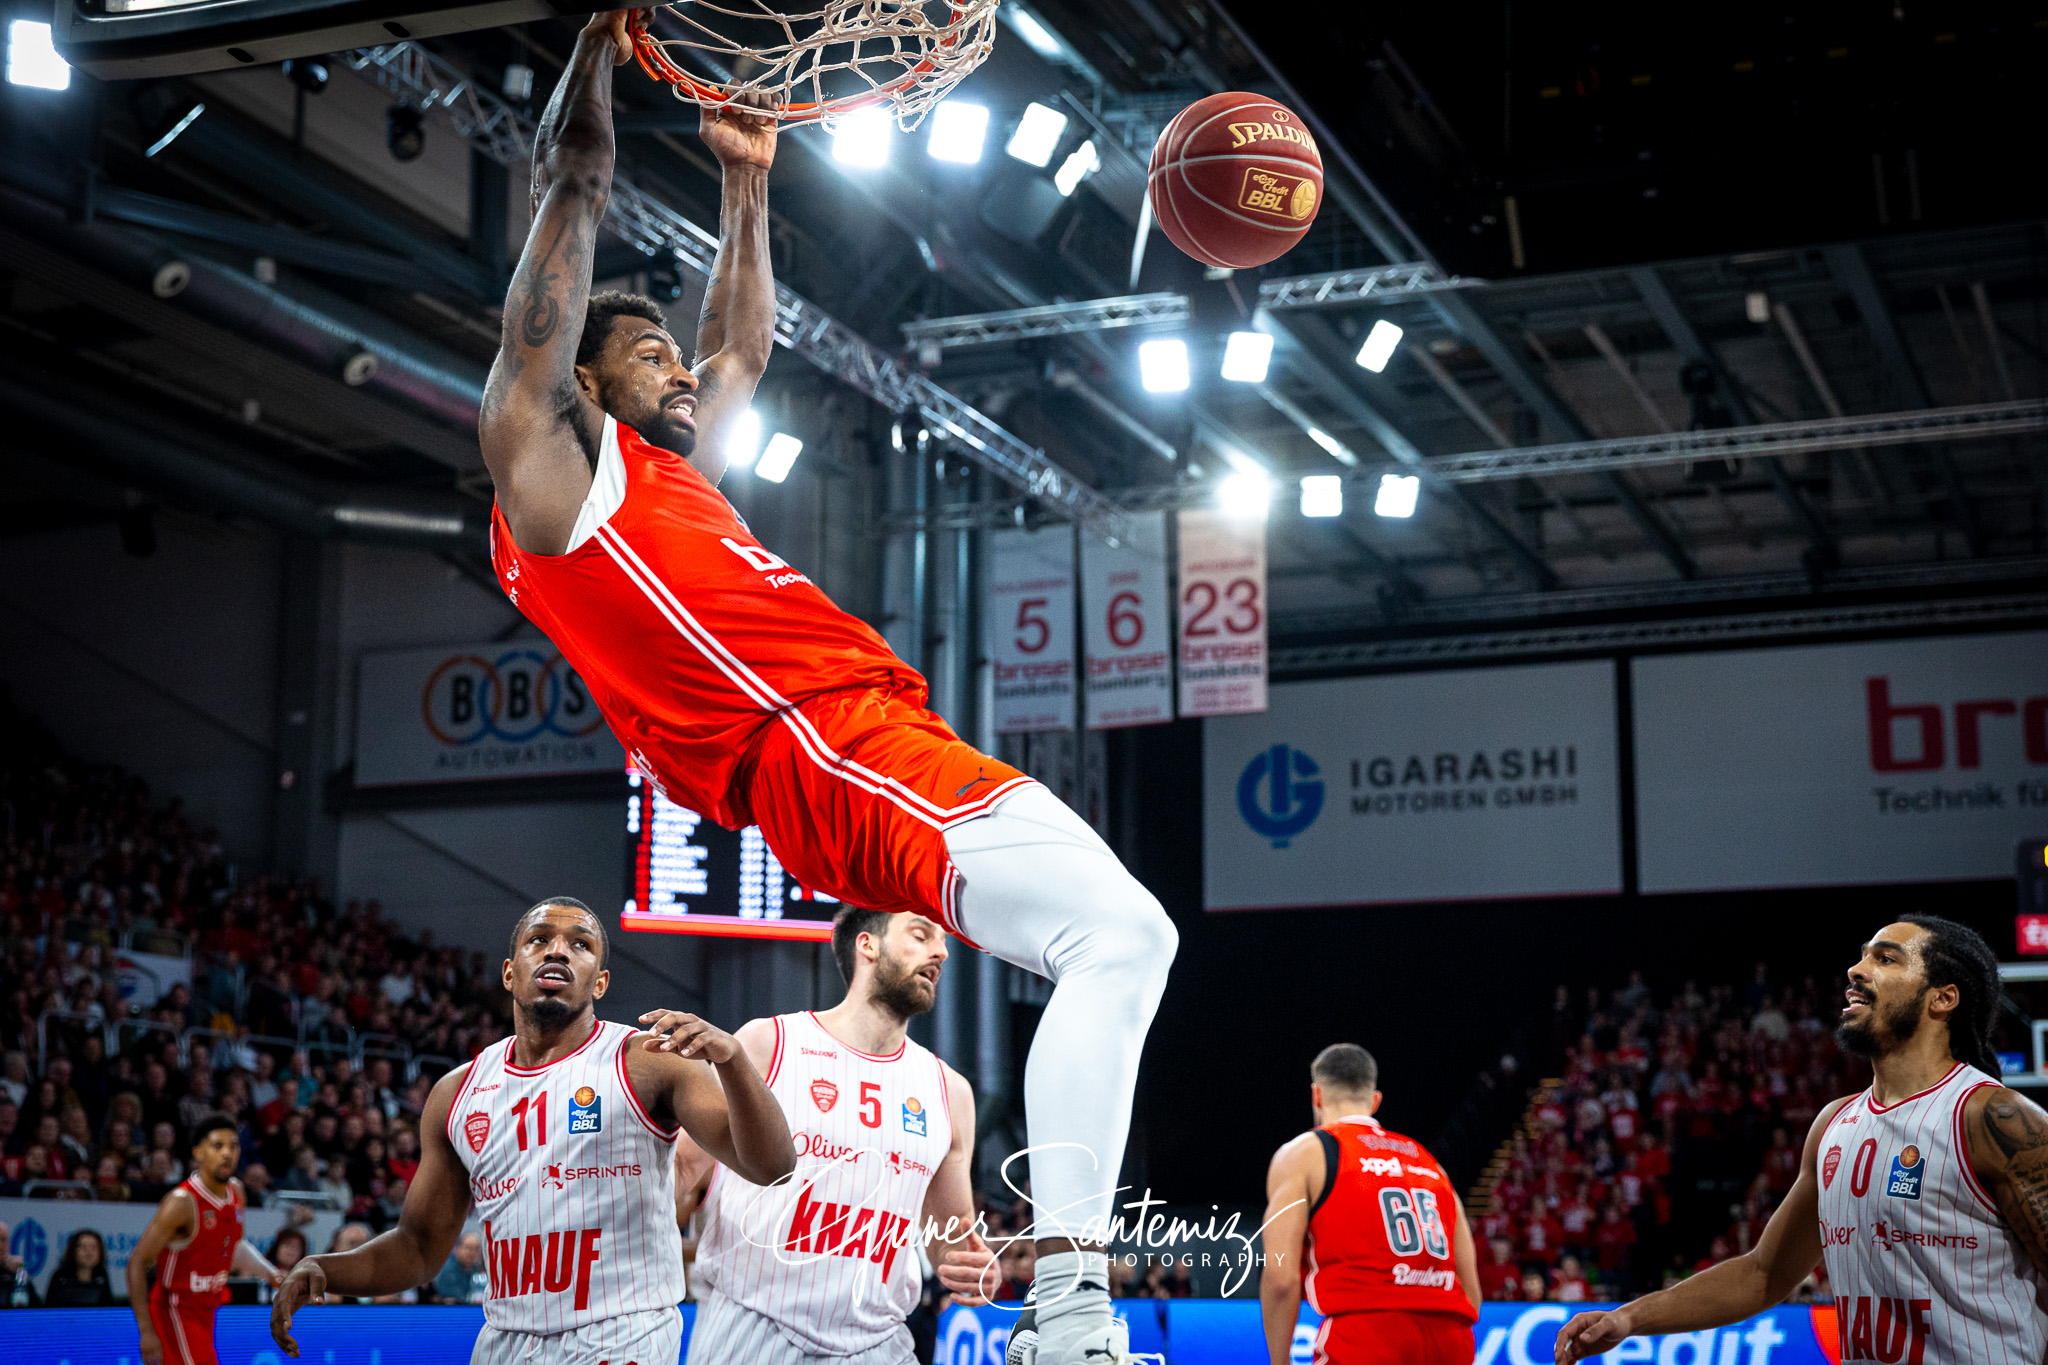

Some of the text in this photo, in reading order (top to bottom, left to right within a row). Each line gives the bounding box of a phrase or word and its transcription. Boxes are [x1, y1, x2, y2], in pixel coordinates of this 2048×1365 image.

[1228, 121, 1321, 164] SPALDIN
[1246, 190, 1284, 212] BBL
[1015, 597, 1051, 654] 5
[1106, 591, 1145, 649] 6
[1184, 578, 1261, 637] 23
[452, 666, 587, 724] BBS
[436, 743, 597, 770] AUTOMATION
[1350, 745, 1577, 789] IGARASHI
[1350, 793, 1486, 817] MOTOREN
[1875, 784, 2003, 815] Technik
[511, 1091, 548, 1152] 11
[571, 1119, 598, 1131] BBL
[859, 1081, 882, 1128] 5
[564, 1164, 642, 1180] SPRINTIS
[1850, 1138, 1877, 1198] 0
[1890, 1181, 1917, 1196] BBL
[785, 1179, 911, 1284] KNAUF
[1378, 1187, 1450, 1261] 65
[1891, 1230, 1979, 1249] SPRINTIS
[485, 1221, 602, 1310] KNAUF
[1836, 1296, 1931, 1365] NAUF
